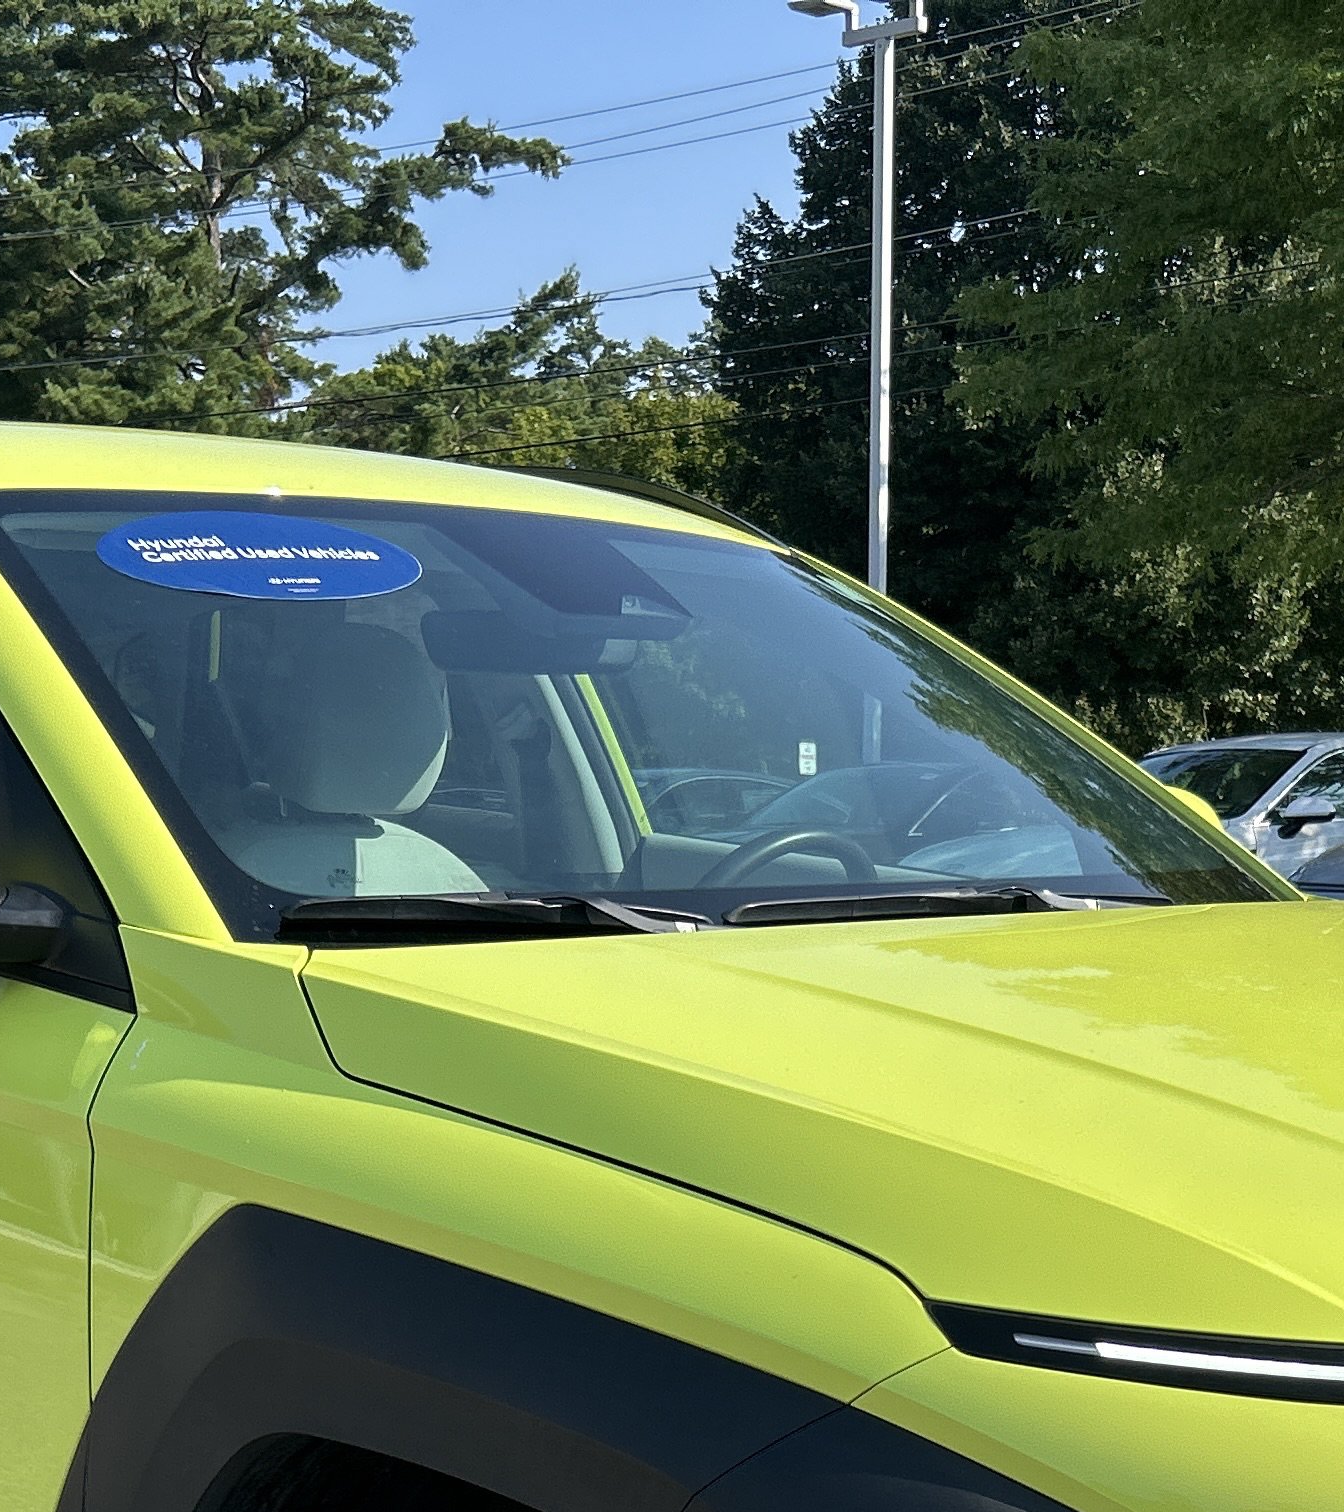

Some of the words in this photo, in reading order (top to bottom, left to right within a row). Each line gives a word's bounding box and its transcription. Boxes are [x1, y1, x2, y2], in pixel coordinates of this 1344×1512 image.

[127, 535, 225, 550] Hyundai
[142, 549, 238, 562] Certified
[239, 546, 295, 559] Used
[292, 547, 380, 561] Vehicles
